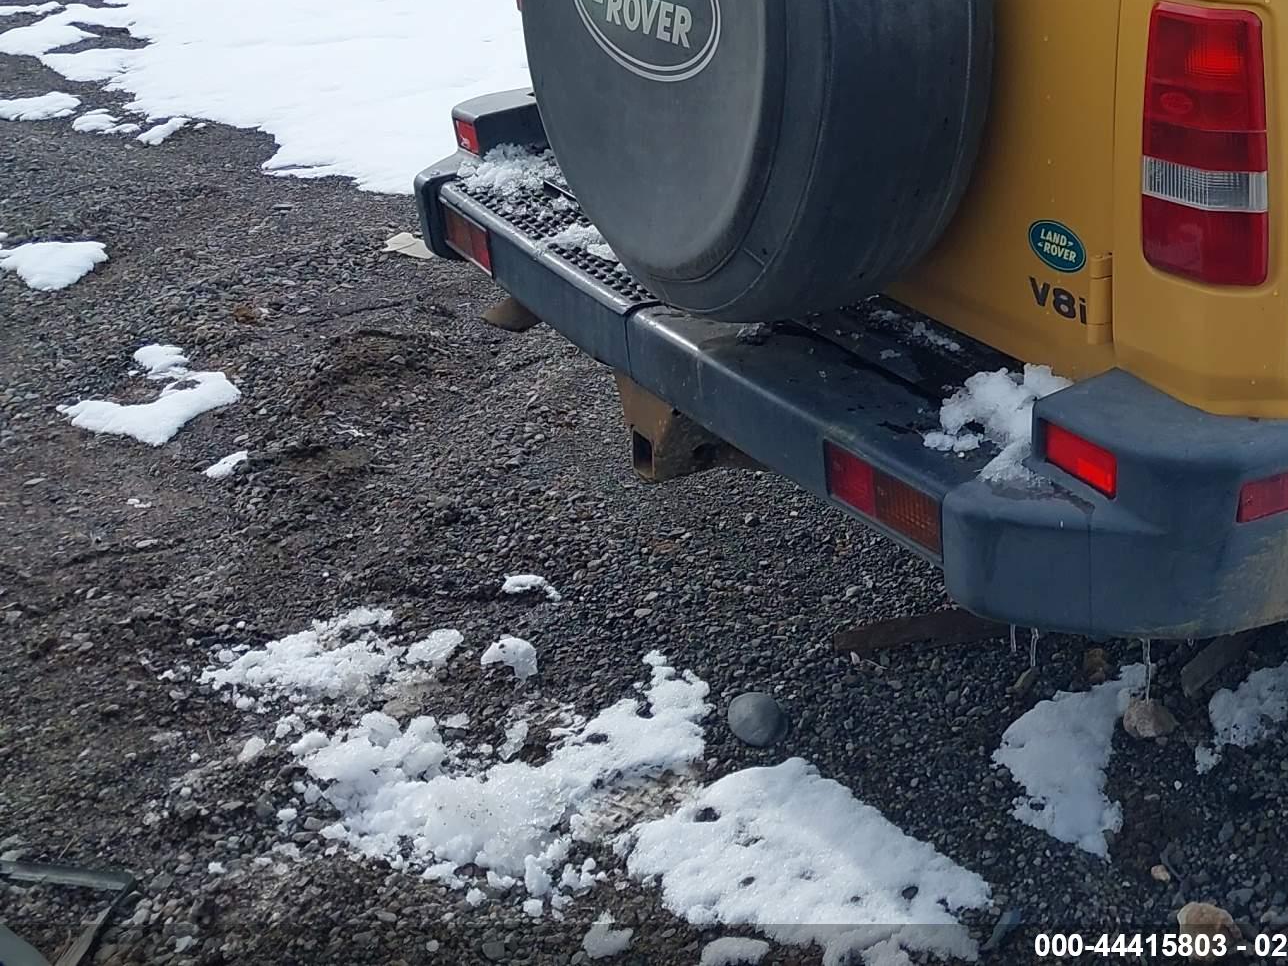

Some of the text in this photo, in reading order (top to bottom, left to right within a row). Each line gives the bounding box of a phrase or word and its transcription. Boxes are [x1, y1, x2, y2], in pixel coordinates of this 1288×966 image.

[1040, 228, 1067, 246] LAND
[1043, 241, 1077, 263] ROVER
[1029, 275, 1087, 325] V8i
